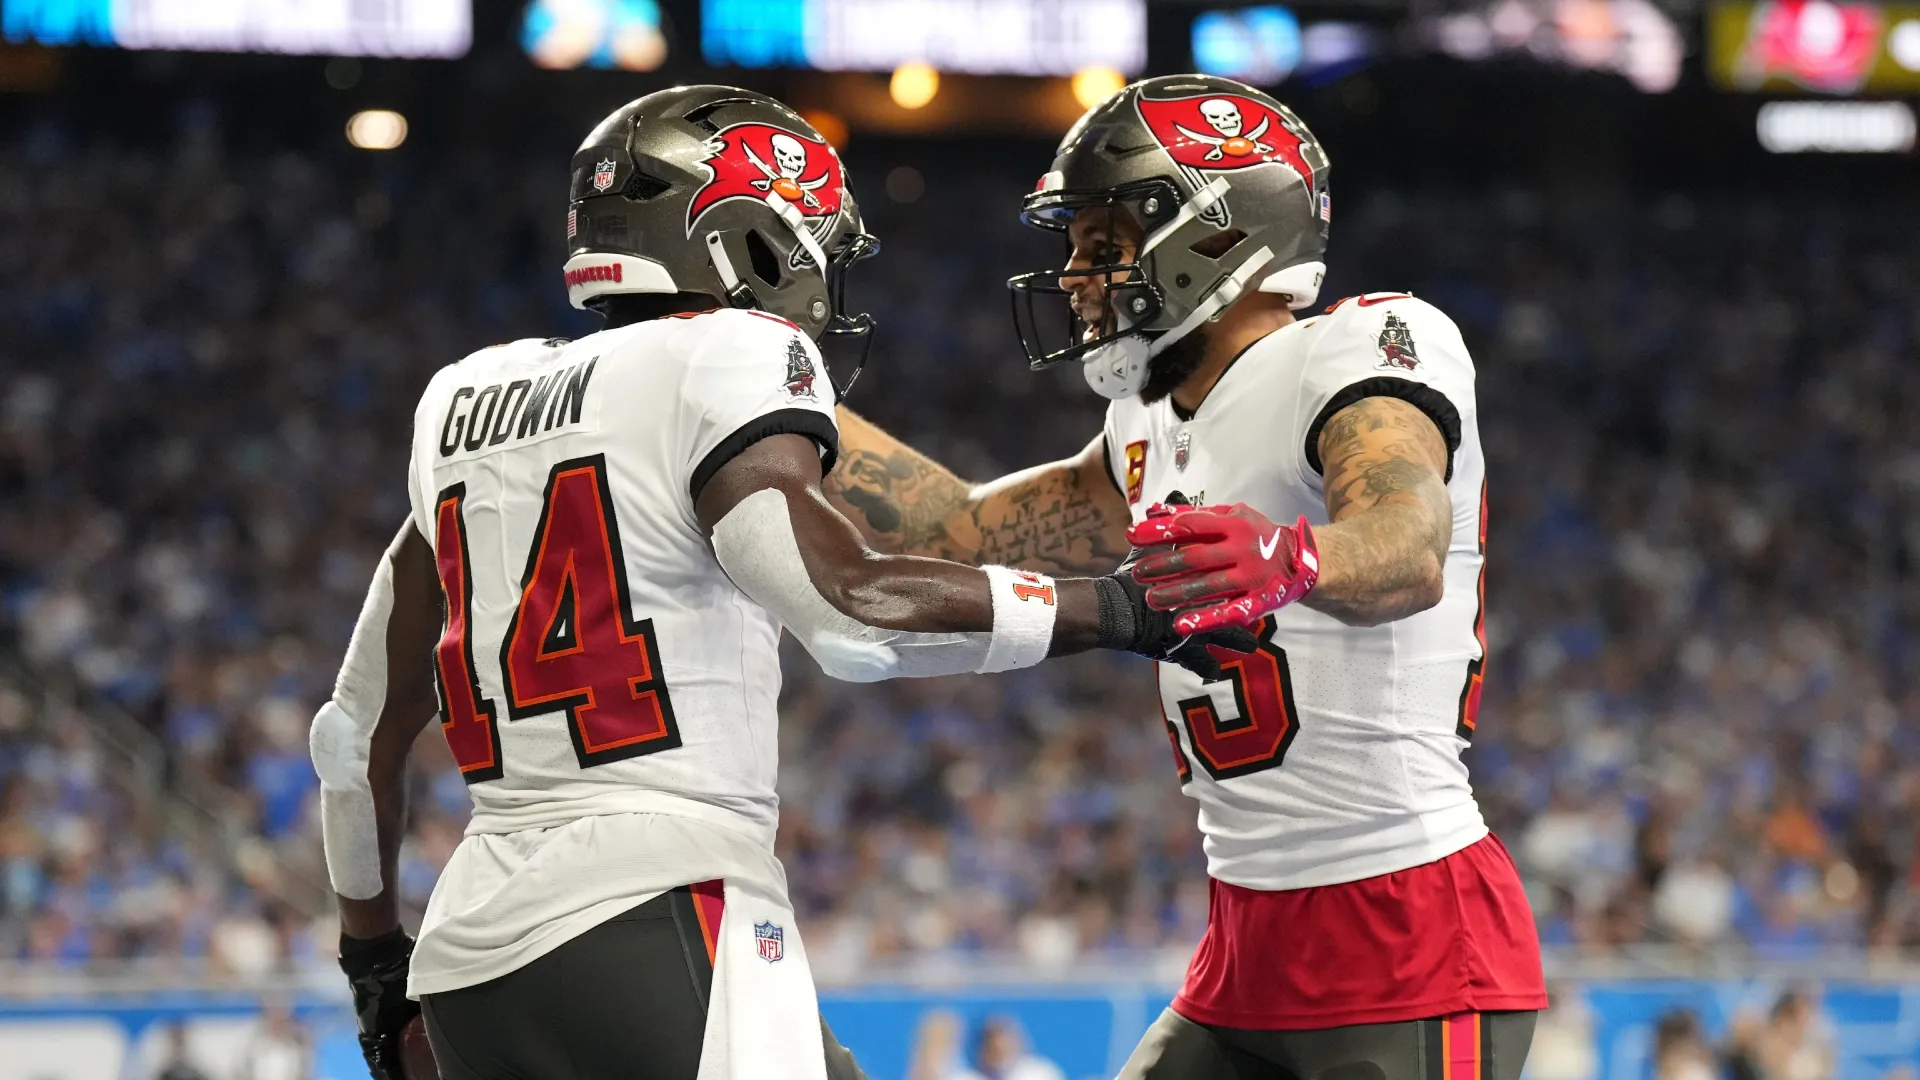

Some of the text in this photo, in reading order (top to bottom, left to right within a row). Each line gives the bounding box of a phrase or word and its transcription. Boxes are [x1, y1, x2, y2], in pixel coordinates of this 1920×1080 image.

[596, 172, 611, 187] NFL
[439, 355, 600, 457] GODWIN
[432, 453, 683, 785] 14
[1155, 612, 1301, 785] 3
[758, 938, 781, 960] NFL
